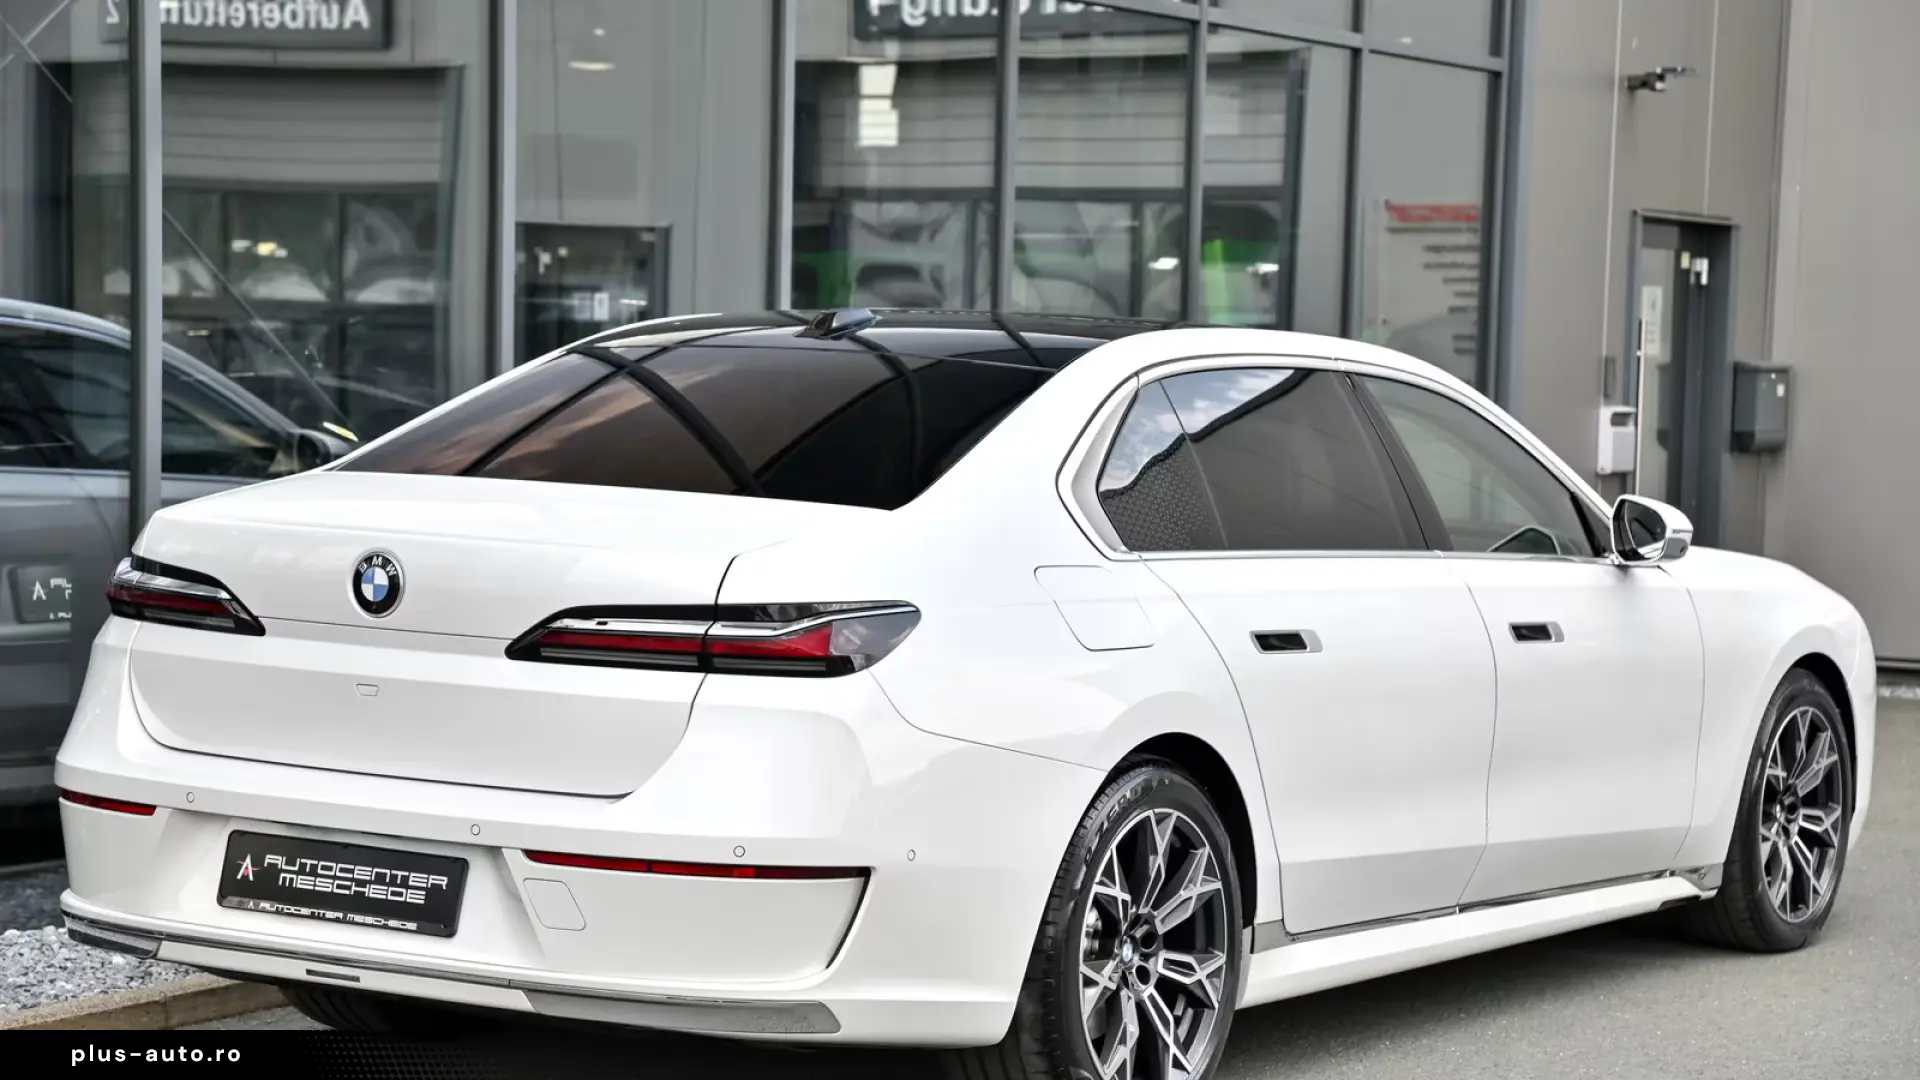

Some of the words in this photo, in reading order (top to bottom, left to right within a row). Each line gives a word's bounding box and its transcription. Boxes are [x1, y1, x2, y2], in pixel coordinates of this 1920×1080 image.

[359, 555, 397, 576] BMW
[264, 854, 448, 889] AUTOCENTER
[279, 873, 426, 904] MESCHEDE
[259, 902, 343, 920] AUTOCENTER
[346, 914, 417, 931] MESCHEDE
